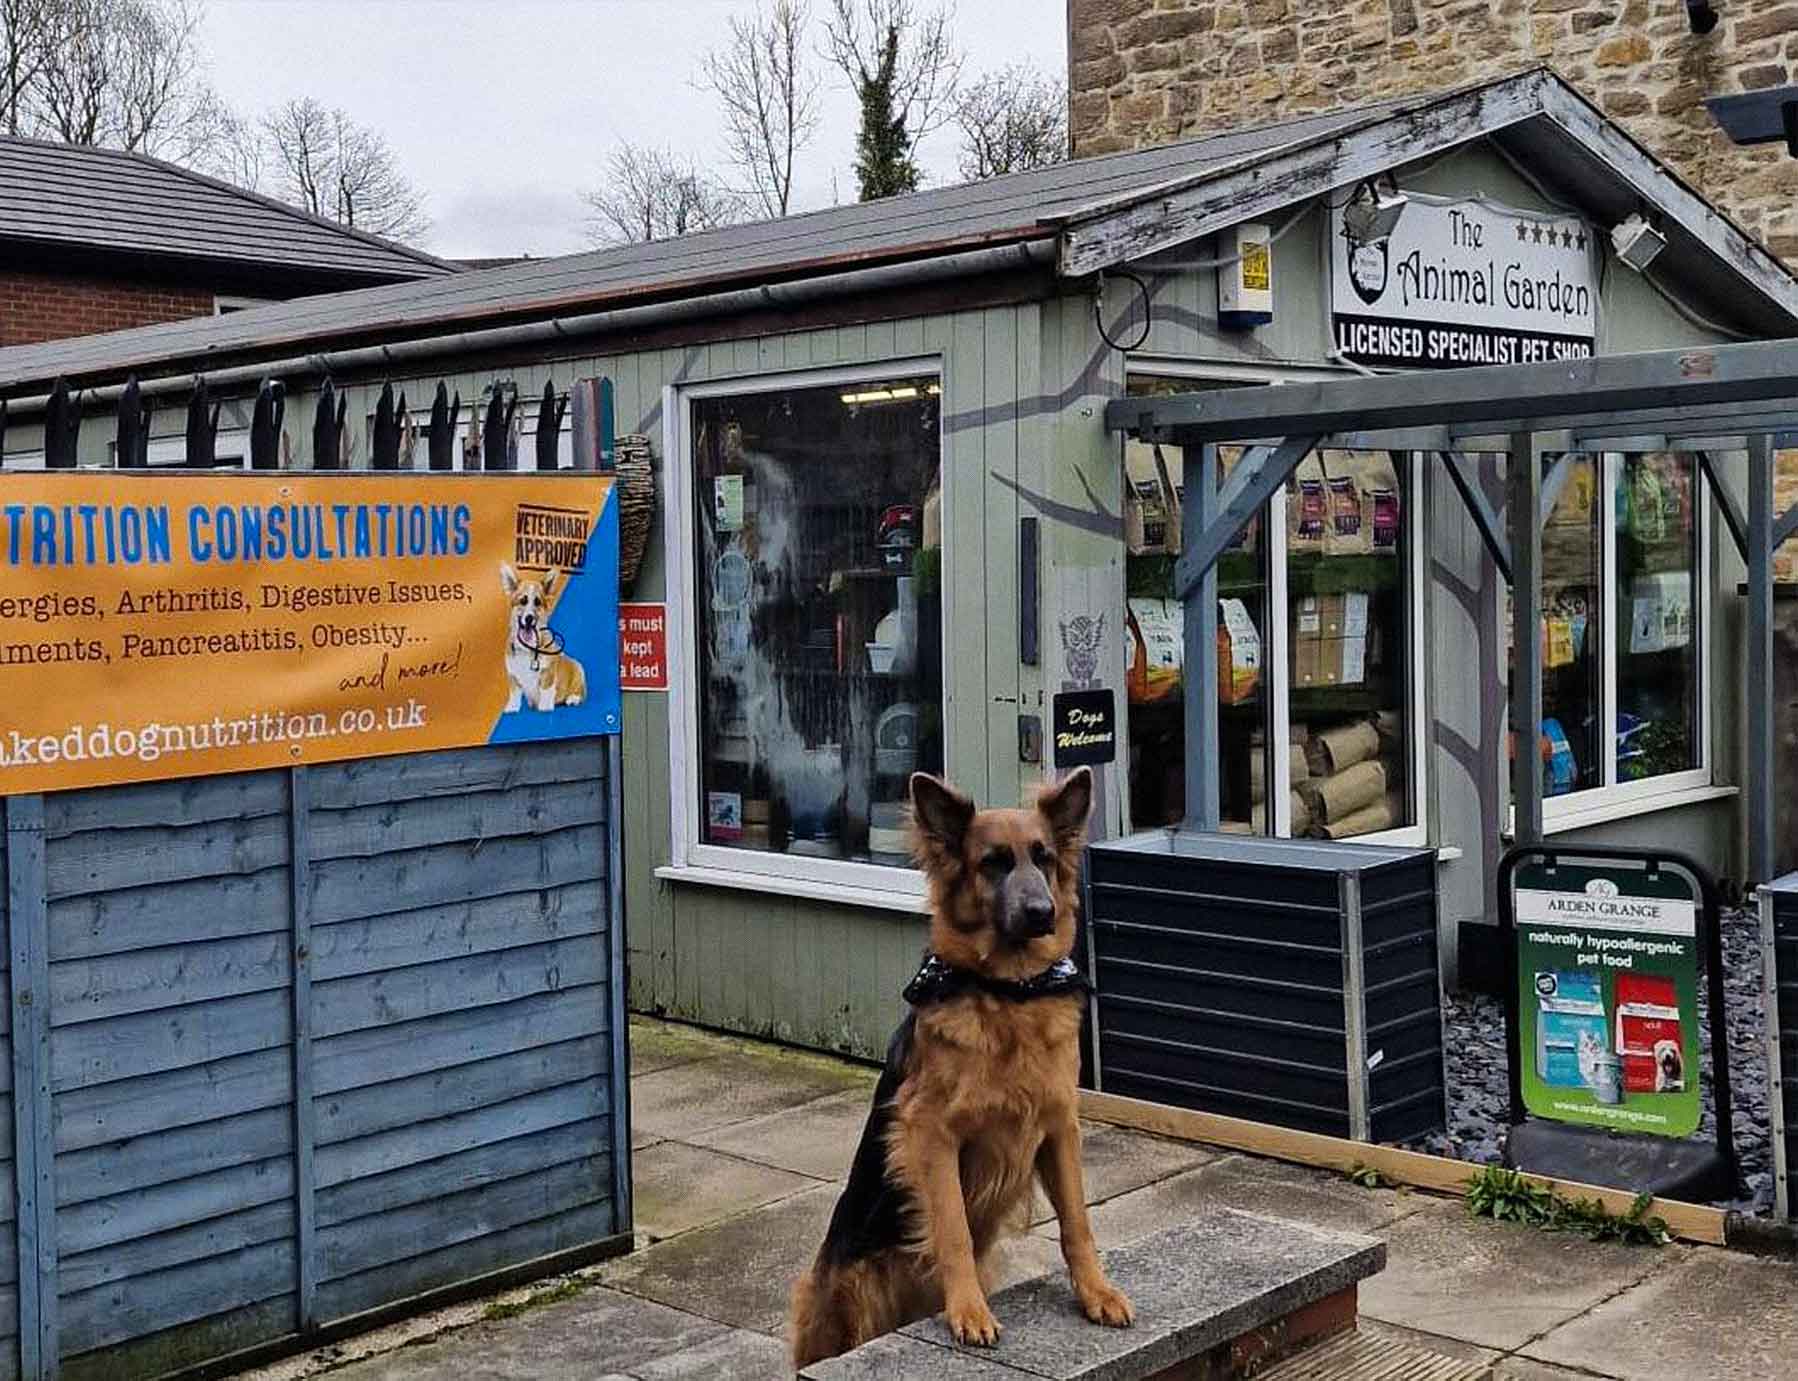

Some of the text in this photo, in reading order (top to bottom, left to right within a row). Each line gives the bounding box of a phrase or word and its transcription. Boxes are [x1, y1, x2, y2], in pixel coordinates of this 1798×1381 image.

[1448, 210, 1483, 250] The
[1396, 249, 1495, 307] Animal
[1503, 262, 1589, 319] Garden
[1339, 322, 1590, 364] LICENSED SPECIALIST PET SHOP
[4, 503, 471, 566] TRITION CONSULTATIONS
[516, 511, 589, 540] VETERINARY
[515, 537, 588, 568] APPROVED
[0, 581, 472, 622] ergies, Arthritis, Digestive Issues,
[629, 615, 663, 632] must
[121, 627, 303, 659] Pancreatitis,
[311, 623, 428, 649] Obesity...
[623, 638, 653, 659] kept
[339, 642, 462, 691] and more!
[630, 661, 660, 678] lead
[1067, 708, 1105, 727] Dogs
[1056, 731, 1113, 748] Welcome
[1548, 899, 1661, 918] ARDEN GRANGE
[1528, 931, 1685, 955] naturally hypoallergenic
[1577, 953, 1633, 968] pet food
